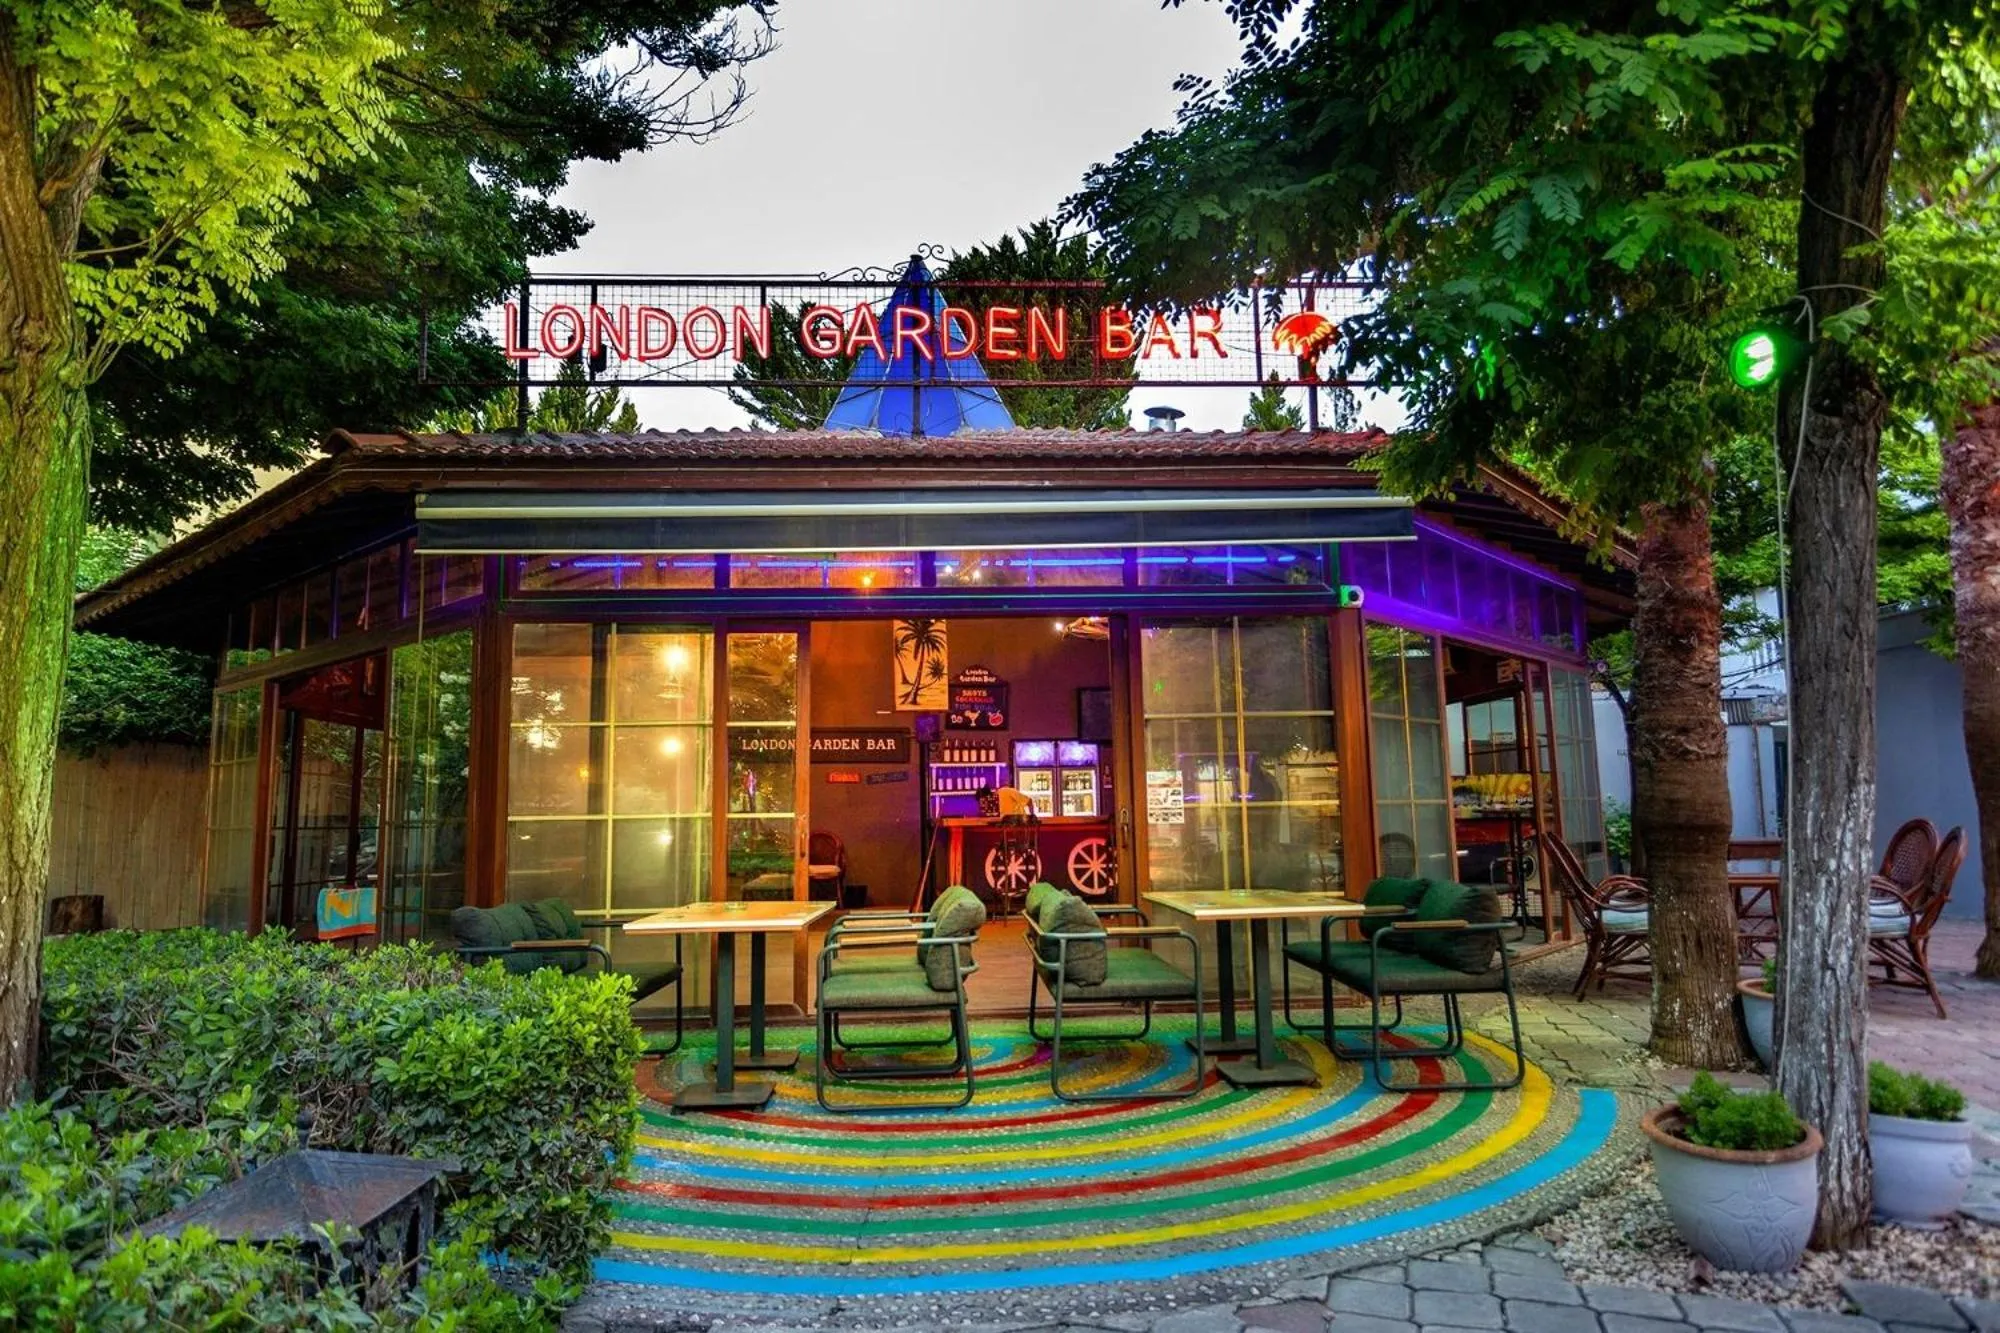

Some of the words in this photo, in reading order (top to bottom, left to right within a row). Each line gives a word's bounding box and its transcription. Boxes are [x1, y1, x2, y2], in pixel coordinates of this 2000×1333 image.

[504, 302, 772, 361] LONDON
[800, 303, 1066, 361] GARDEN
[1101, 304, 1228, 359] BAR
[742, 739, 796, 750] LONDON
[809, 739, 860, 750] ARDEN
[866, 739, 896, 750] BAR
